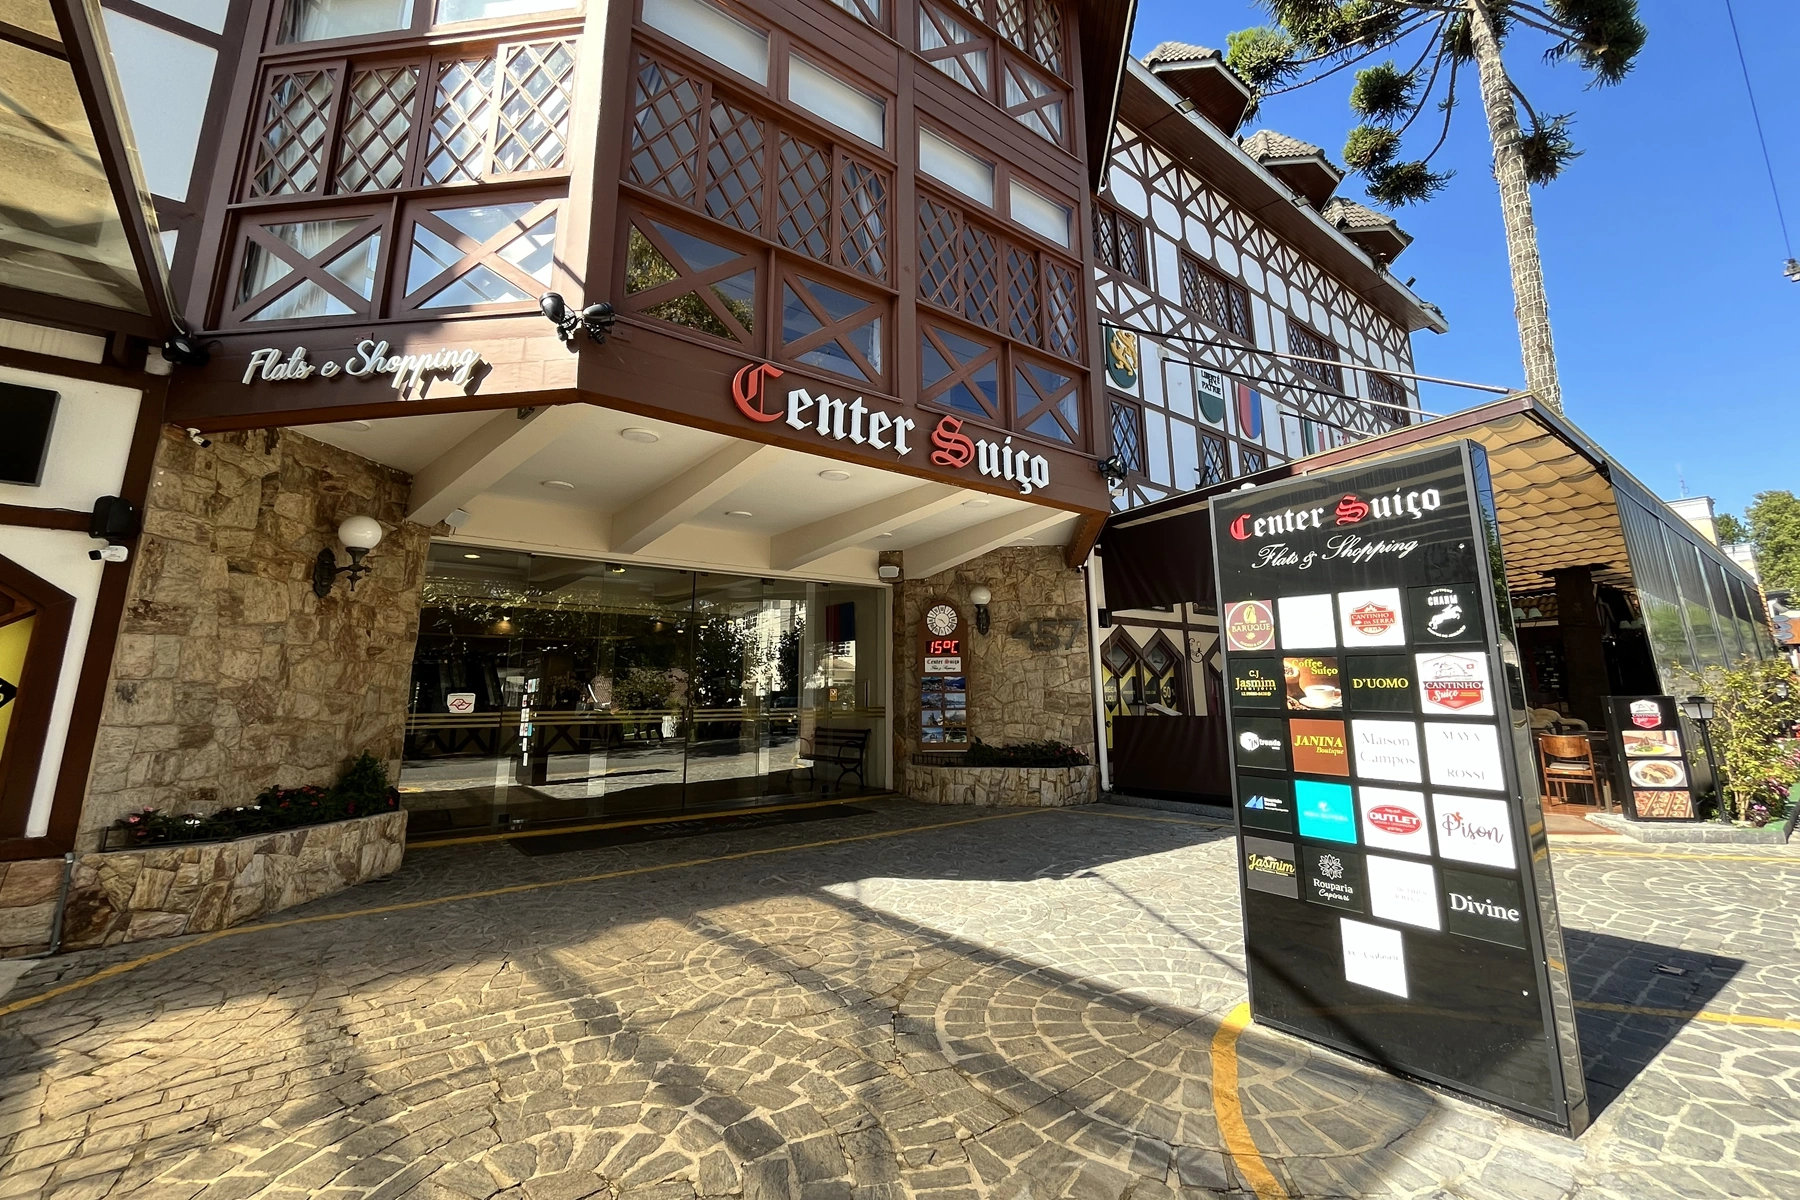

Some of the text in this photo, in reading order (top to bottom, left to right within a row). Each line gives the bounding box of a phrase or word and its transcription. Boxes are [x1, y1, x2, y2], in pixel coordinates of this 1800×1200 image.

[242, 339, 481, 388] Flats e Shopping
[731, 362, 1050, 495] Center Suiço
[1230, 487, 1441, 541] Center Suiço
[1251, 542, 1299, 569] Flats
[1322, 534, 1419, 564] Shopping
[1427, 594, 1458, 606] CHARM
[1351, 612, 1389, 620] CANTINHO
[1372, 617, 1394, 625] SERRA
[1231, 623, 1271, 633] BARUQUE
[1011, 620, 1083, 652] 457
[1291, 658, 1323, 668] Coffee
[1235, 676, 1276, 691] Jasmim
[1425, 681, 1481, 689] CANTINHO
[1294, 734, 1344, 748] JANINA
[1361, 732, 1410, 746] Maison
[1316, 746, 1345, 757] Boutique
[1360, 751, 1416, 767] Campos
[1447, 768, 1485, 780] ROSSI
[1369, 811, 1420, 825] OUTLET
[1248, 853, 1296, 873] Jasmim
[1312, 877, 1354, 894] Rouparia
[1448, 892, 1520, 922] Divine
